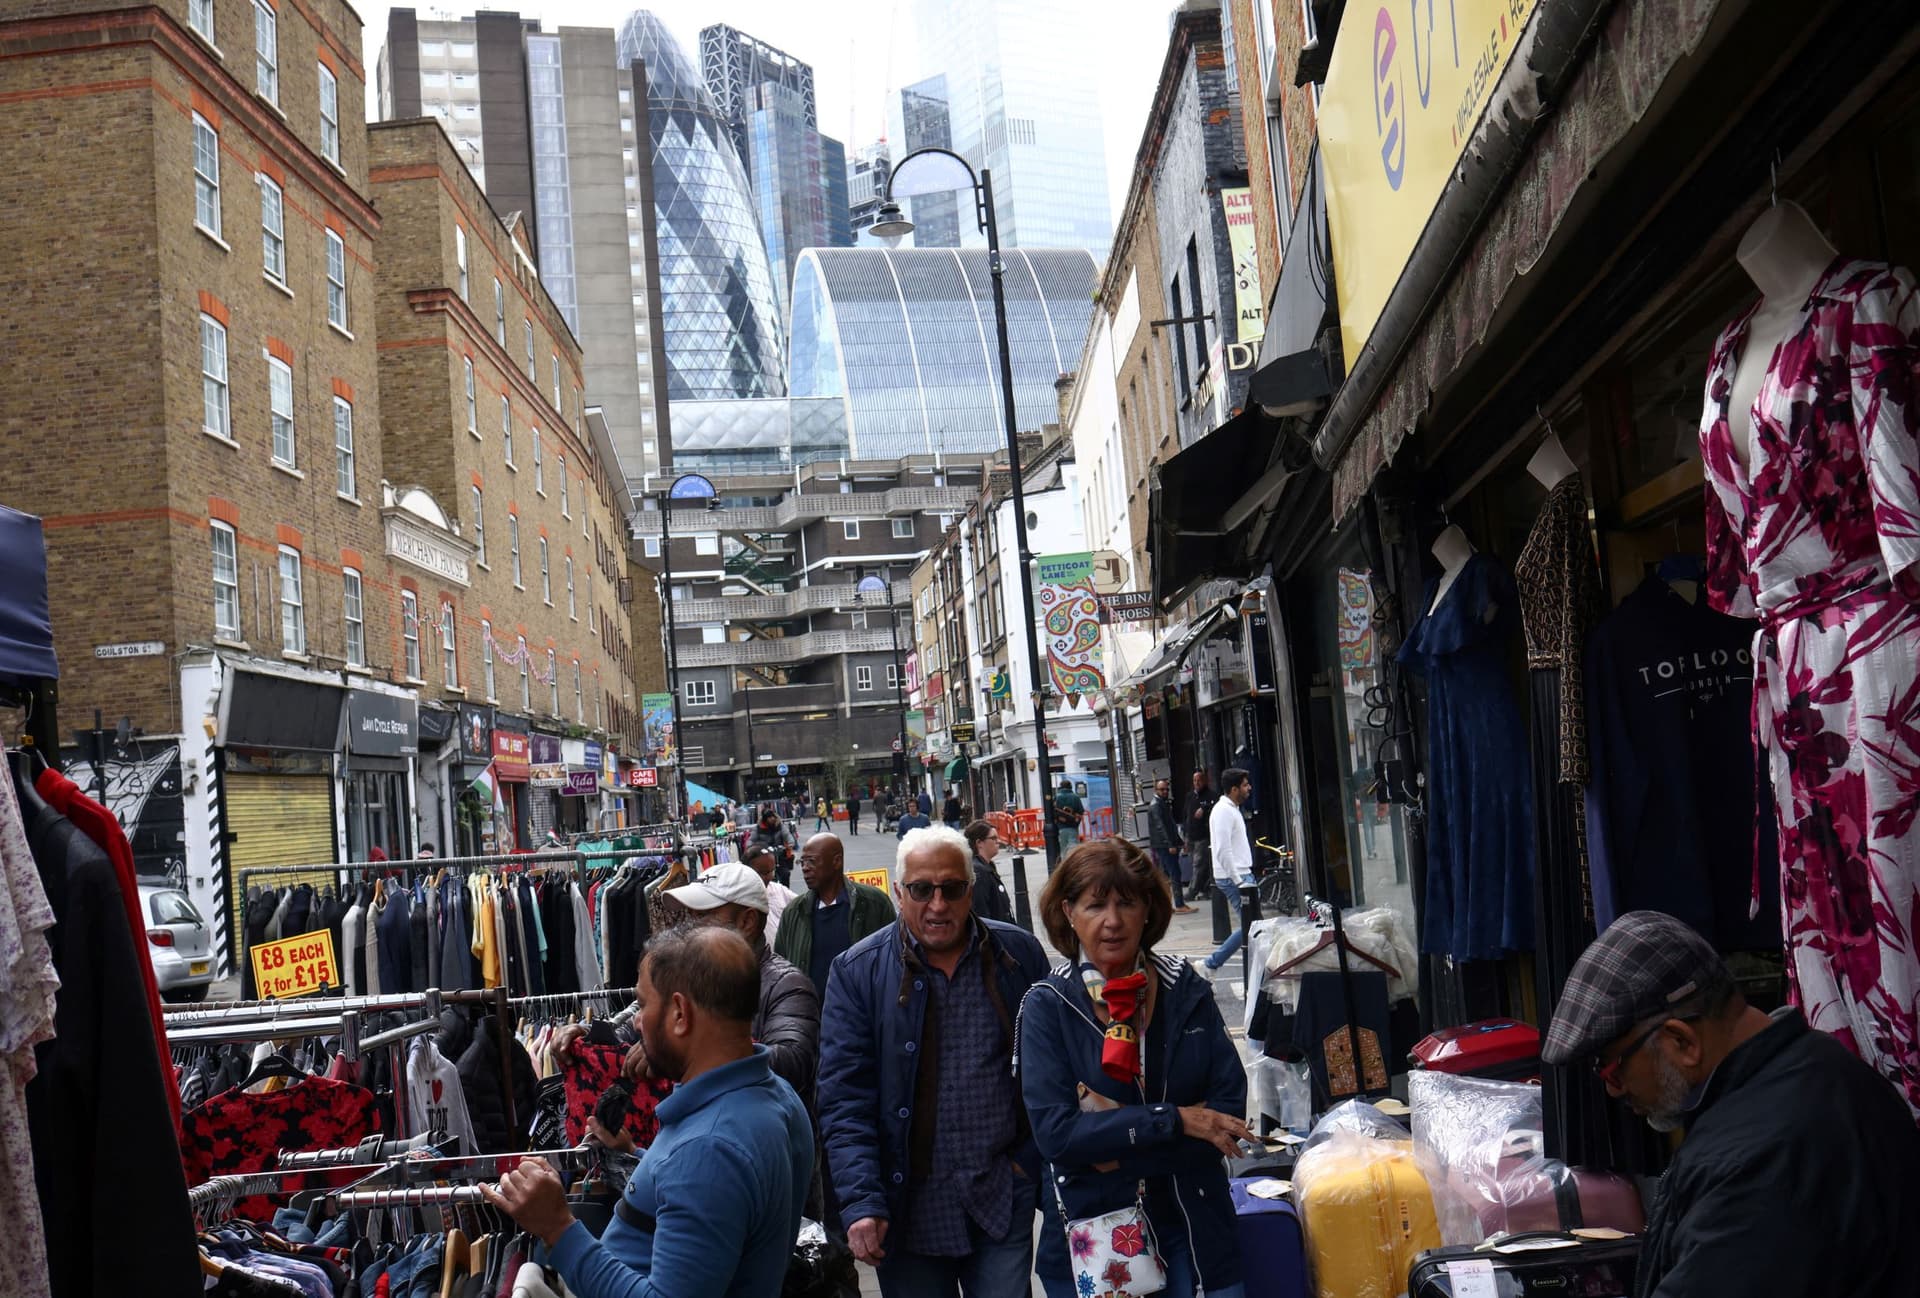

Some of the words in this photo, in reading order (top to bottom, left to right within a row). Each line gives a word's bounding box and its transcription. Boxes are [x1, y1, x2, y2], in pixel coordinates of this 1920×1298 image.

[1456, 28, 1500, 138] WHOLESALE
[394, 530, 436, 569] MERCHANT
[439, 550, 464, 580] HOUSE
[1041, 560, 1090, 573] PETTICOAT
[1042, 570, 1066, 580] LANE
[374, 717, 391, 734] CYCLE
[391, 720, 409, 735] REPAIR
[567, 773, 594, 791] Nida
[632, 777, 654, 785] OPEN
[260, 946, 285, 971] £8
[289, 942, 325, 964] EACH
[263, 980, 272, 995] 2
[274, 977, 292, 993] for
[294, 960, 330, 987] £15
